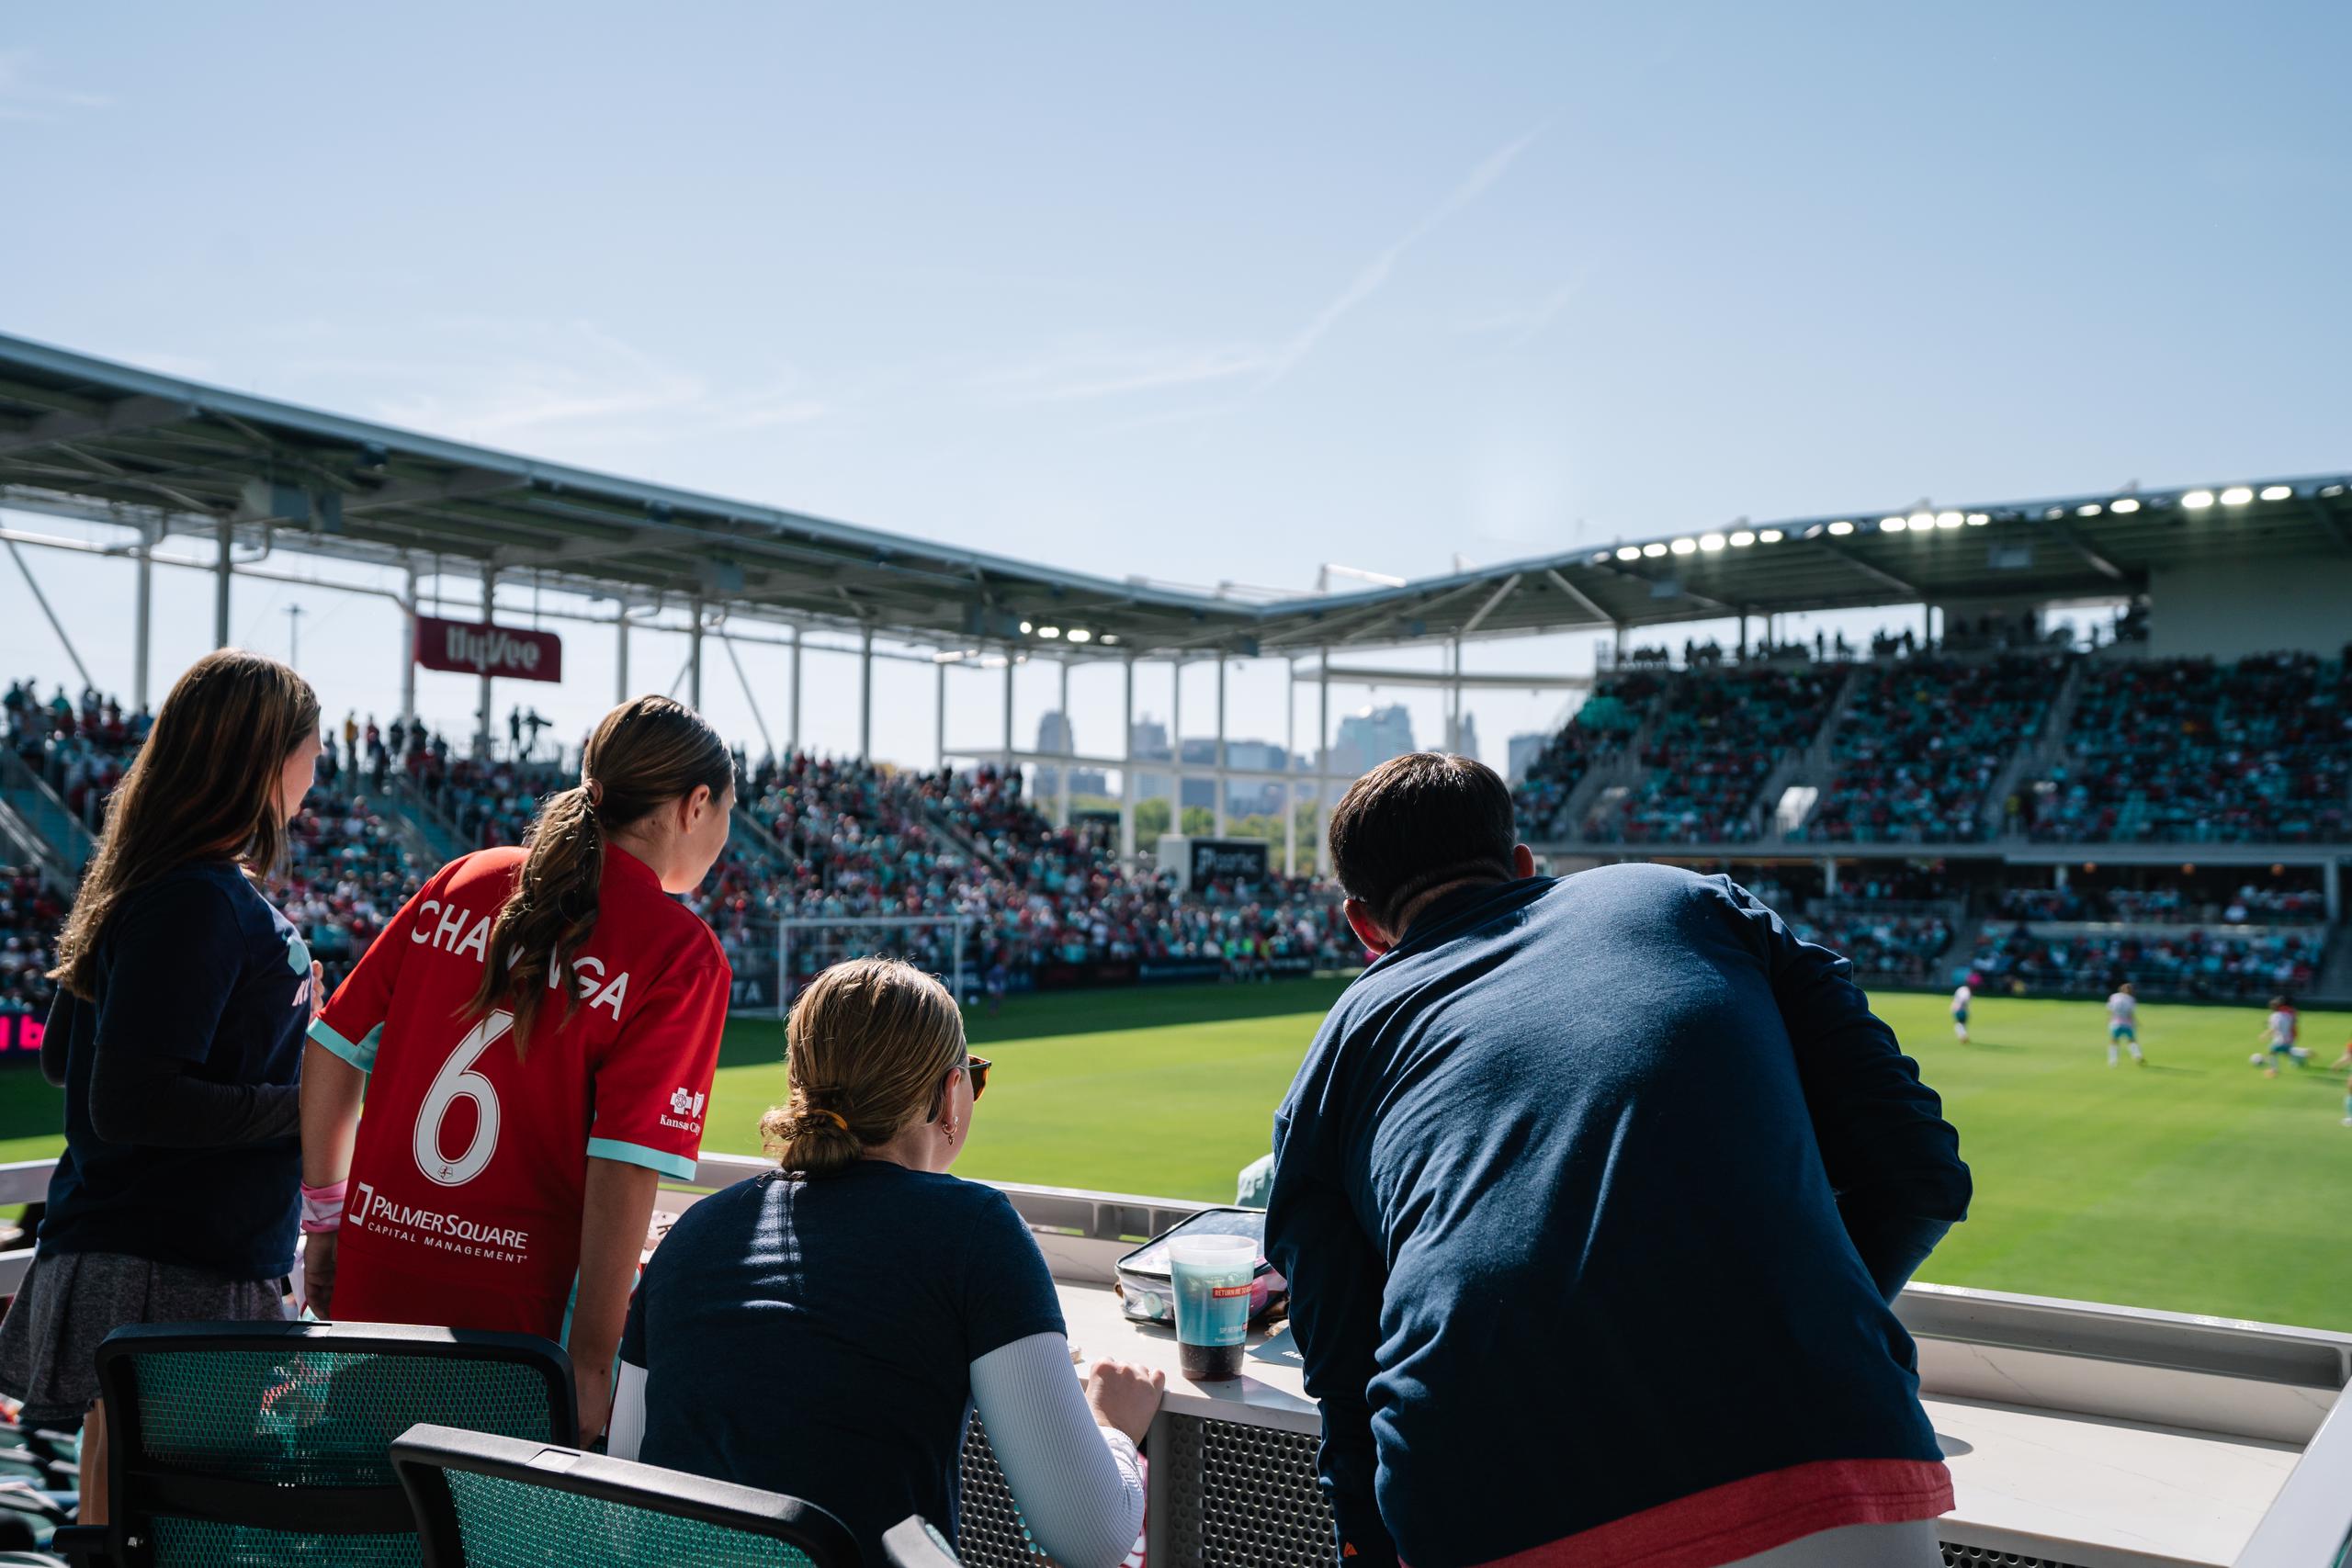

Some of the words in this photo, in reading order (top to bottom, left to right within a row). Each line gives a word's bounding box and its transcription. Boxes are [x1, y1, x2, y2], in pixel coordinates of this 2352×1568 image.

[412, 899, 629, 1021] CHAGA
[413, 1008, 515, 1188] 6
[368, 1222, 416, 1243] CAPITAL
[1215, 1288, 1235, 1296] RETURN
